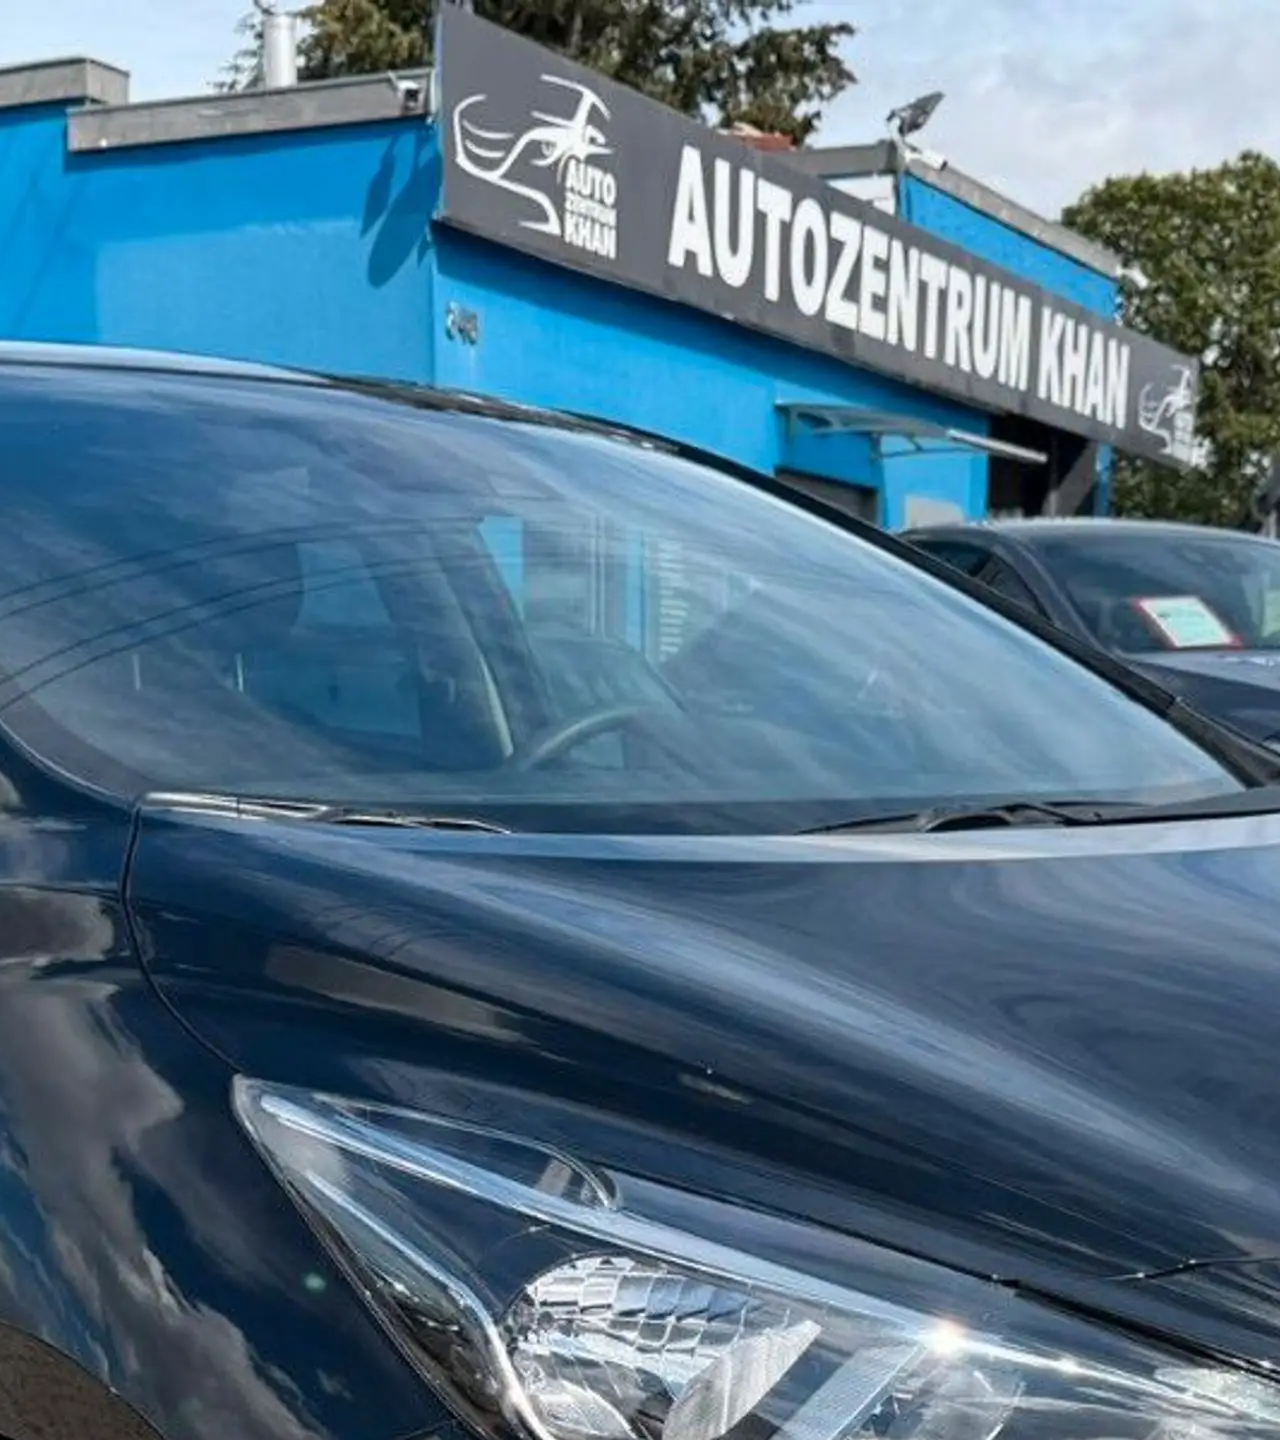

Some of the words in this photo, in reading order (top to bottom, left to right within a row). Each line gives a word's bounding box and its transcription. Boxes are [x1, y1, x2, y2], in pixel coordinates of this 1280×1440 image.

[565, 158, 616, 208] AUTO
[564, 210, 616, 260] KHAN
[668, 145, 1032, 391] AUTOZENTRUM
[1038, 306, 1130, 429] KHAN
